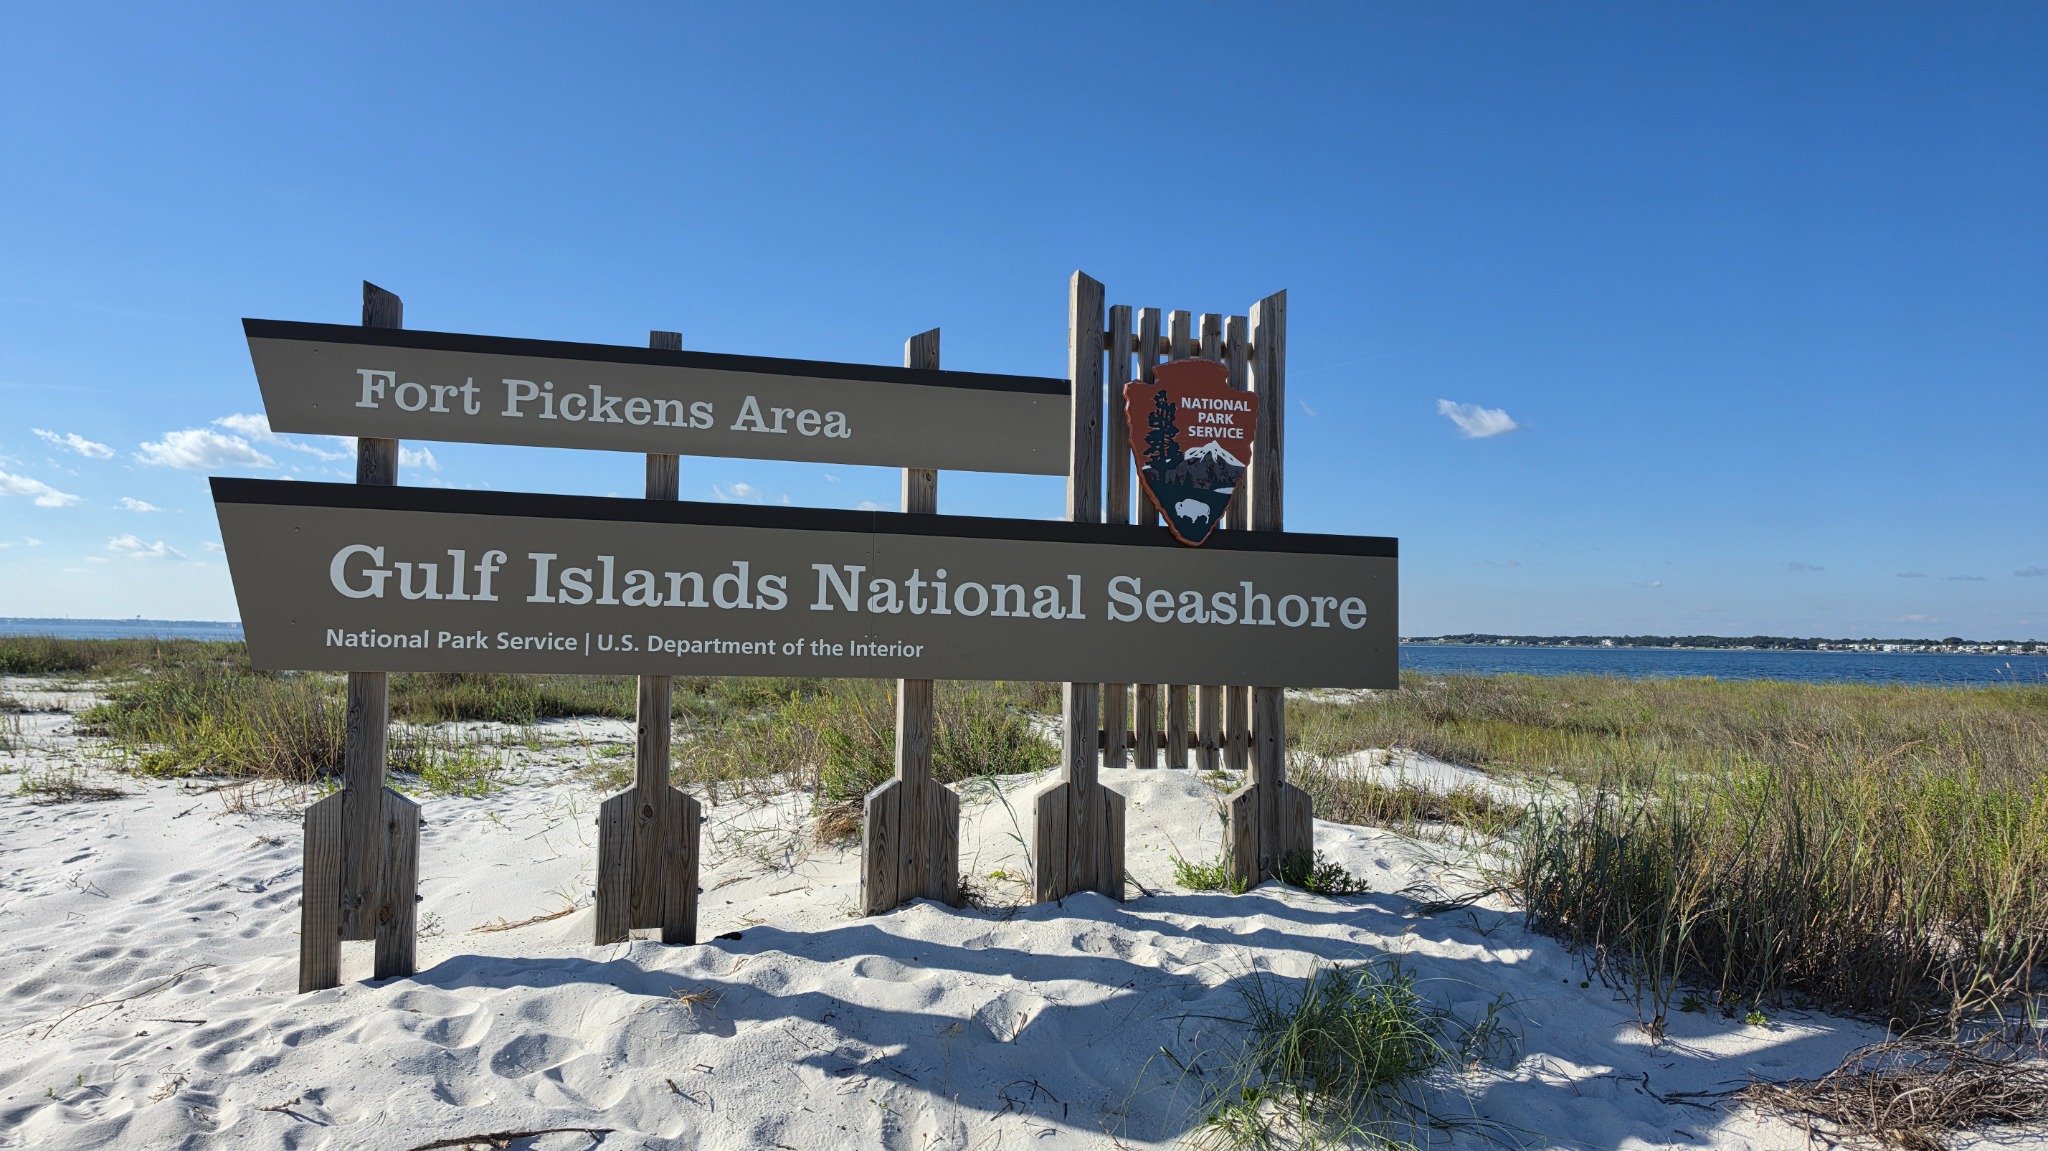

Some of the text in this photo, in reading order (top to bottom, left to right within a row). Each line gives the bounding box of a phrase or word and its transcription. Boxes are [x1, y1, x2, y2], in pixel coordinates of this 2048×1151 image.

[355, 368, 852, 439] Fort Pickens Area
[1181, 396, 1252, 412] NATIONAL
[1198, 411, 1234, 425] PARK
[1188, 425, 1244, 439] SERVICE
[329, 544, 1367, 630] Gulf Islands National Seashore
[326, 628, 429, 649] National
[437, 630, 489, 649] Park
[496, 631, 578, 651] Service
[597, 633, 639, 652] U.S.
[647, 635, 777, 658] Department
[782, 637, 805, 656] of
[809, 638, 844, 657] the
[850, 640, 924, 658] Interior
